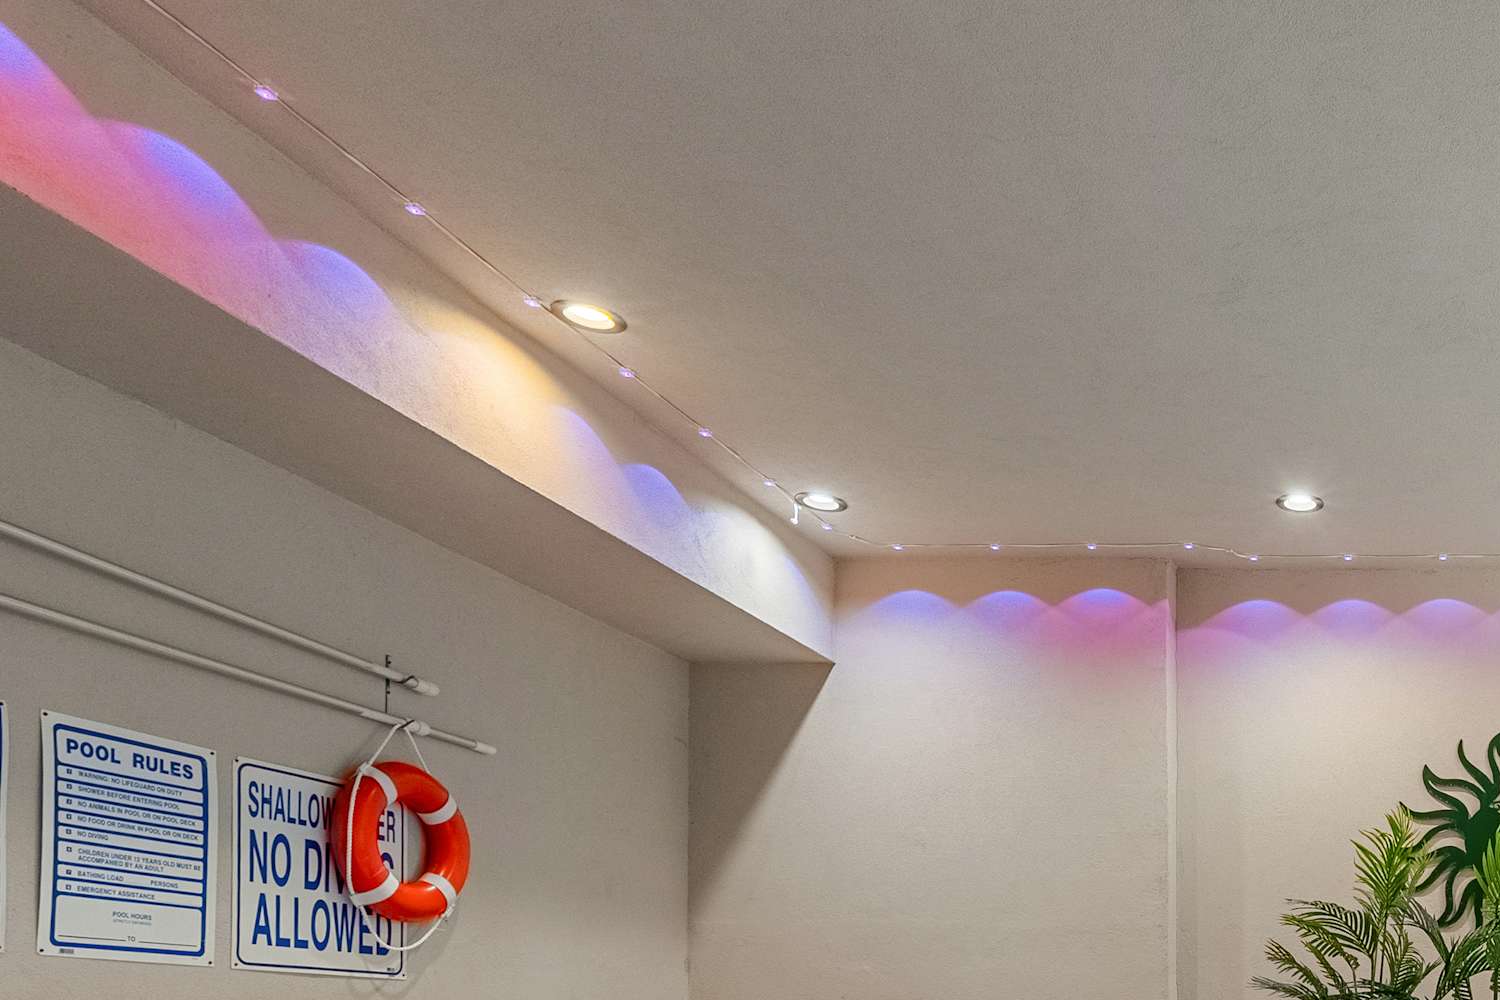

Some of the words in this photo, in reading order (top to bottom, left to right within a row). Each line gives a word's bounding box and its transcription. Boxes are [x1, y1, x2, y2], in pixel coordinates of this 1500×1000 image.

[66, 738, 121, 765] POOL
[132, 752, 194, 780] RULES
[78, 785, 105, 795] SHOWER
[106, 791, 130, 800] BEFORE
[132, 796, 162, 807] ENTERING
[163, 801, 180, 810] POOL
[122, 780, 155, 791] LIFEGUARD
[167, 788, 183, 797] DUTY
[88, 802, 116, 813] ANIMALS
[124, 808, 140, 817] POOL
[162, 816, 179, 824] POOL
[248, 780, 336, 831] SHALLOW
[87, 832, 109, 841] DIVING
[88, 817, 105, 826] FOOD
[117, 822, 136, 831] DRINK
[144, 827, 161, 835] POOL
[78, 848, 109, 858] CHILDREN
[110, 853, 132, 861] UNDER
[142, 858, 162, 866] YEARS
[176, 862, 192, 870] MUST
[249, 829, 292, 888] NO
[77, 871, 105, 880] BATHING
[106, 874, 124, 882] LOAD
[150, 880, 178, 889] PERSONS
[77, 885, 117, 895] EMERGENCY
[118, 890, 155, 900] ASSISTANCE
[112, 911, 129, 919] POOL
[130, 913, 152, 921] HOURS
[252, 893, 393, 956] ALLOWED
